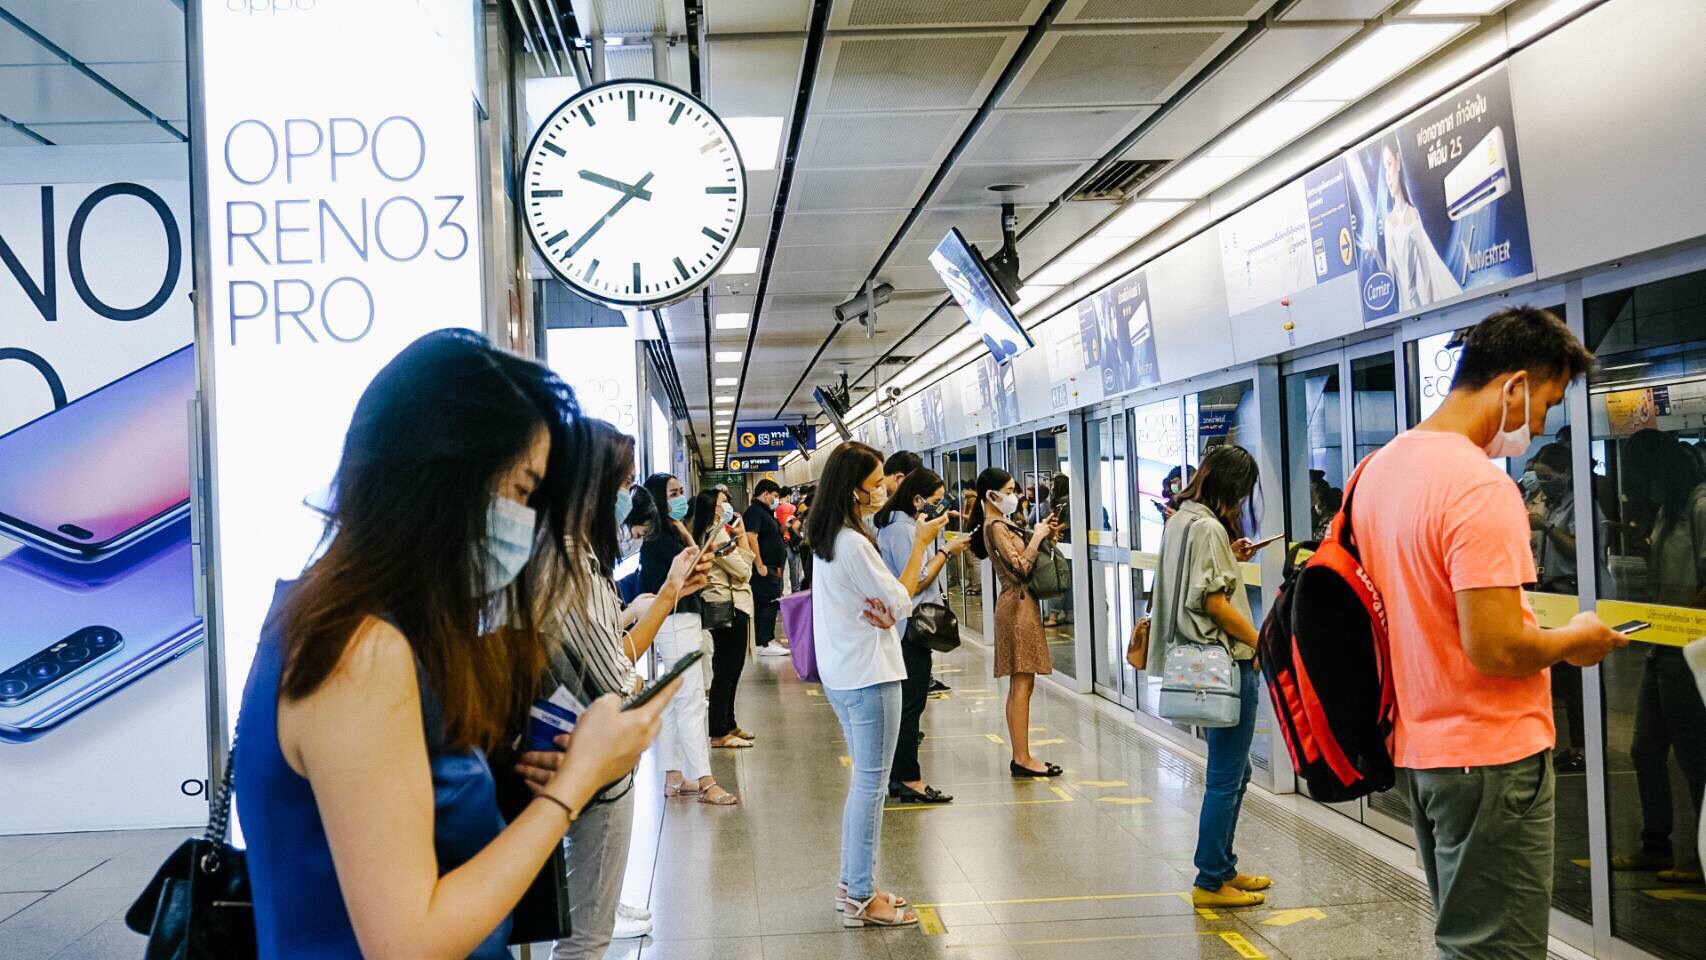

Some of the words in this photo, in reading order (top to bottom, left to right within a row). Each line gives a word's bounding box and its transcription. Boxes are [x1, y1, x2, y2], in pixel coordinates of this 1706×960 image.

[1456, 93, 1487, 129] กำจัดฝุ่น
[224, 115, 426, 184] OPPO
[226, 195, 469, 266] RENO3
[229, 276, 375, 347] PRO
[1367, 281, 1391, 301] Carrier
